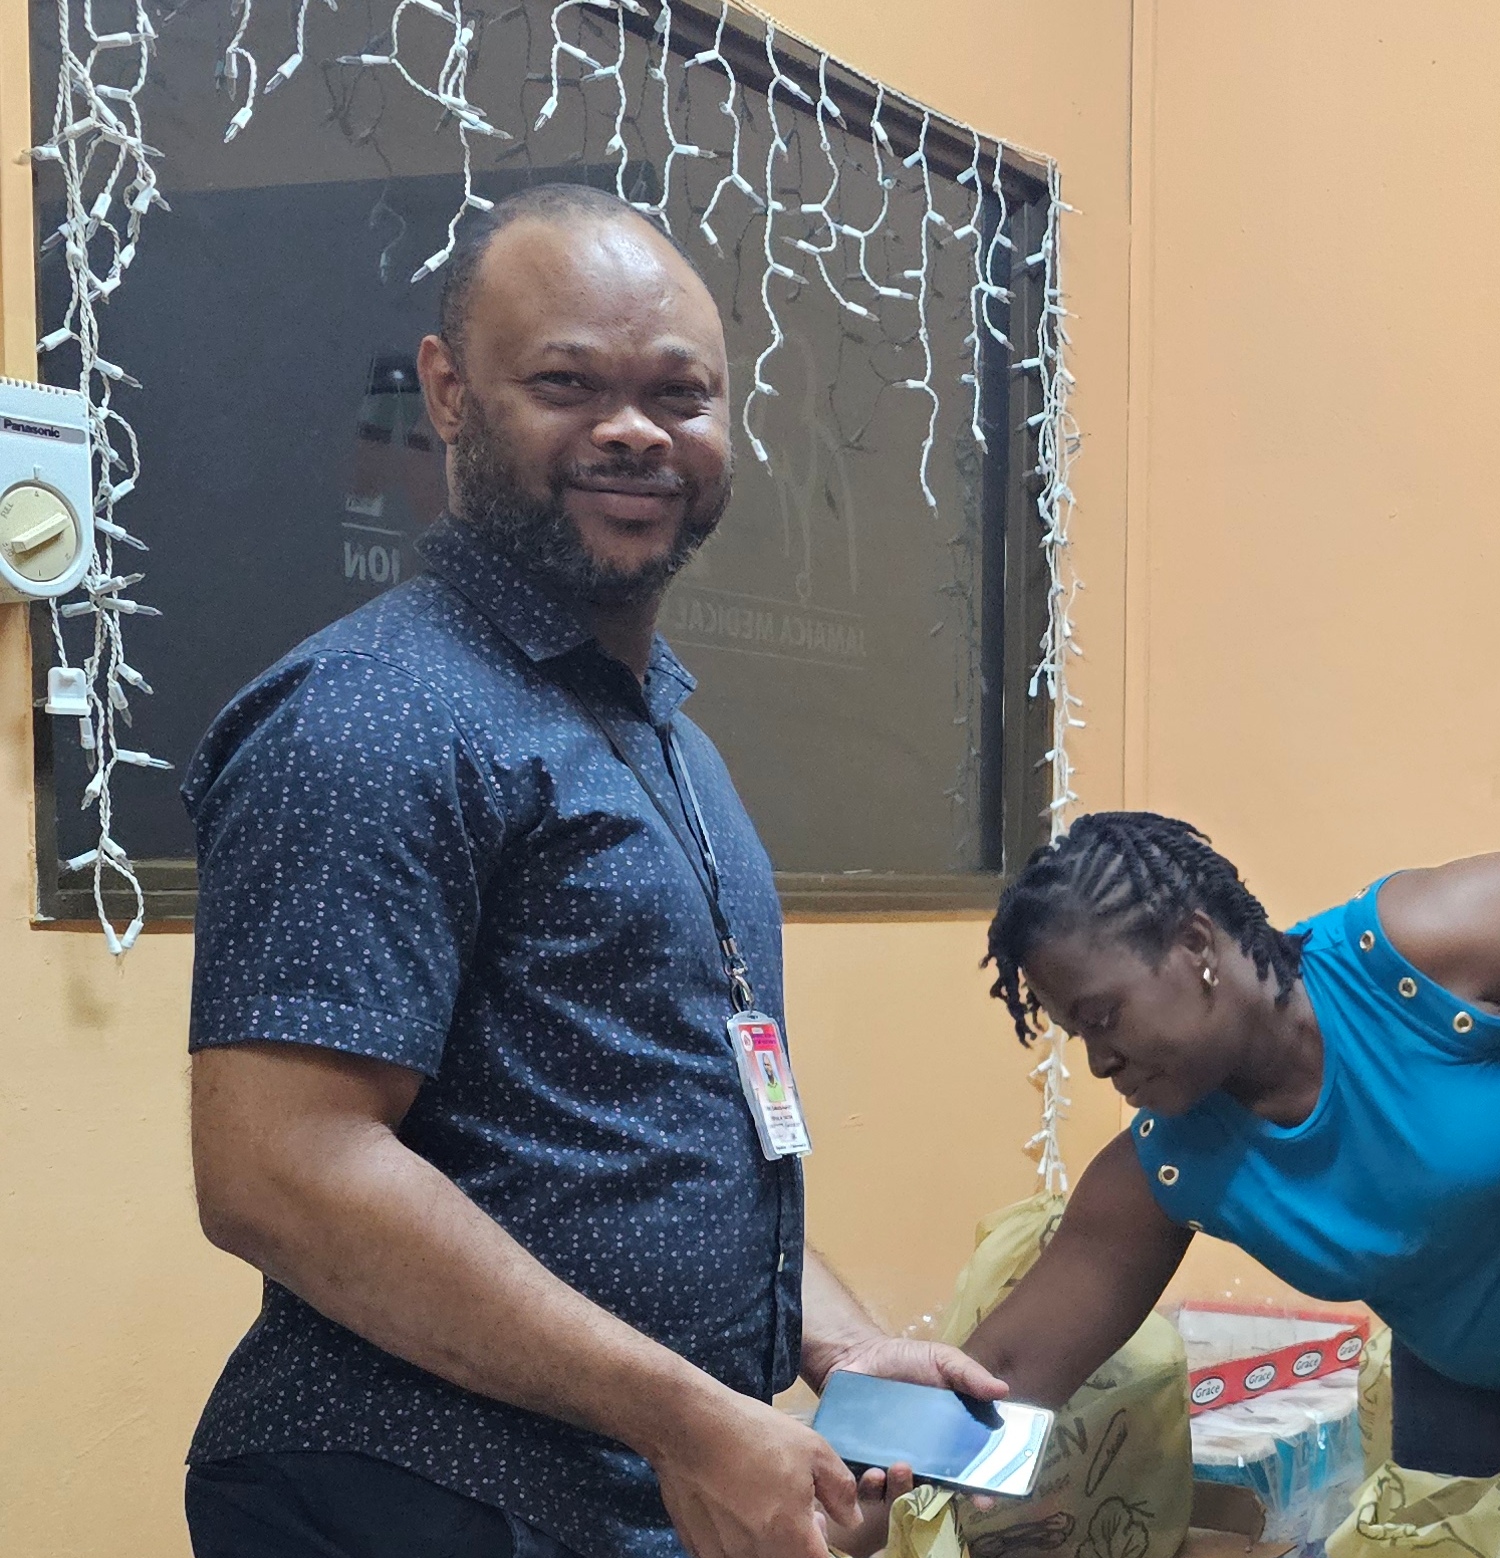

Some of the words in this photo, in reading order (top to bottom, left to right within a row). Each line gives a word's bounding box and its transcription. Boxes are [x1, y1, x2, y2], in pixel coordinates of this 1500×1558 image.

[4, 419, 60, 438] Panasonic
[1, 503, 14, 519] FULL
[1339, 1343, 1359, 1356] Grace
[1295, 1358, 1319, 1370] Grace
[1248, 1371, 1272, 1384] Grace
[1195, 1383, 1220, 1399] Grace
